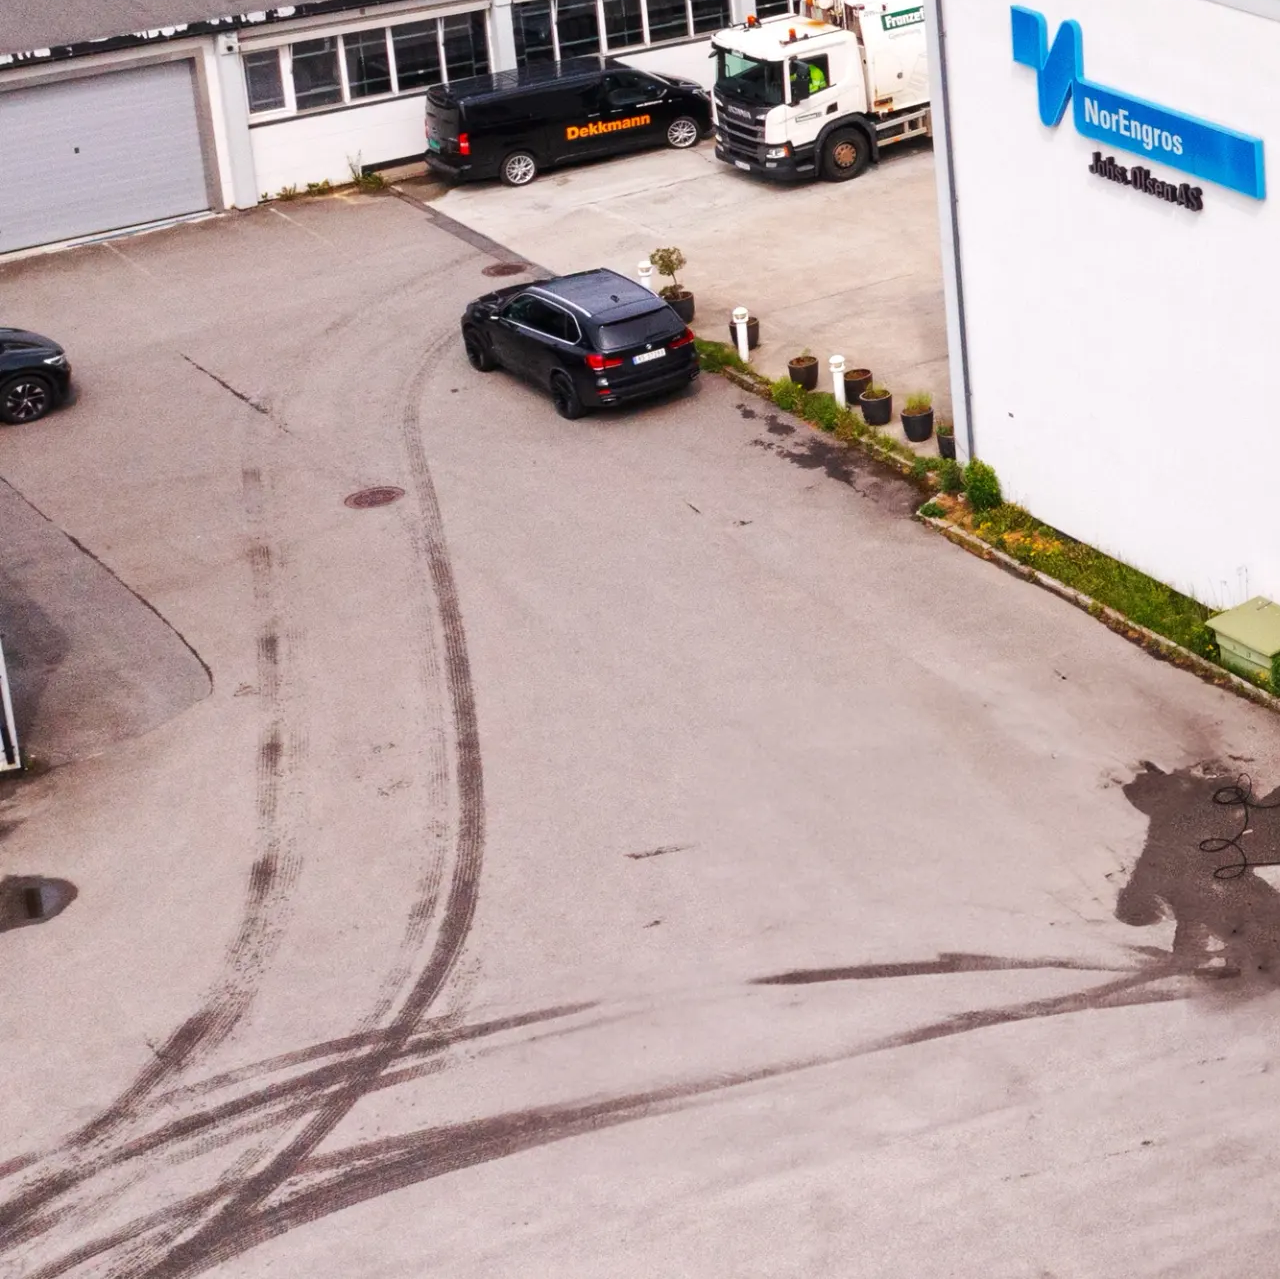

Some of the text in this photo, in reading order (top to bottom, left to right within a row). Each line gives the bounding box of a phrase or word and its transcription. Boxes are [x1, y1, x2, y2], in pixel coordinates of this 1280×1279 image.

[566, 114, 651, 140] Dekkmann
[1084, 97, 1183, 155] NorEngros
[1089, 151, 1203, 211] Johs. Olsen AS
